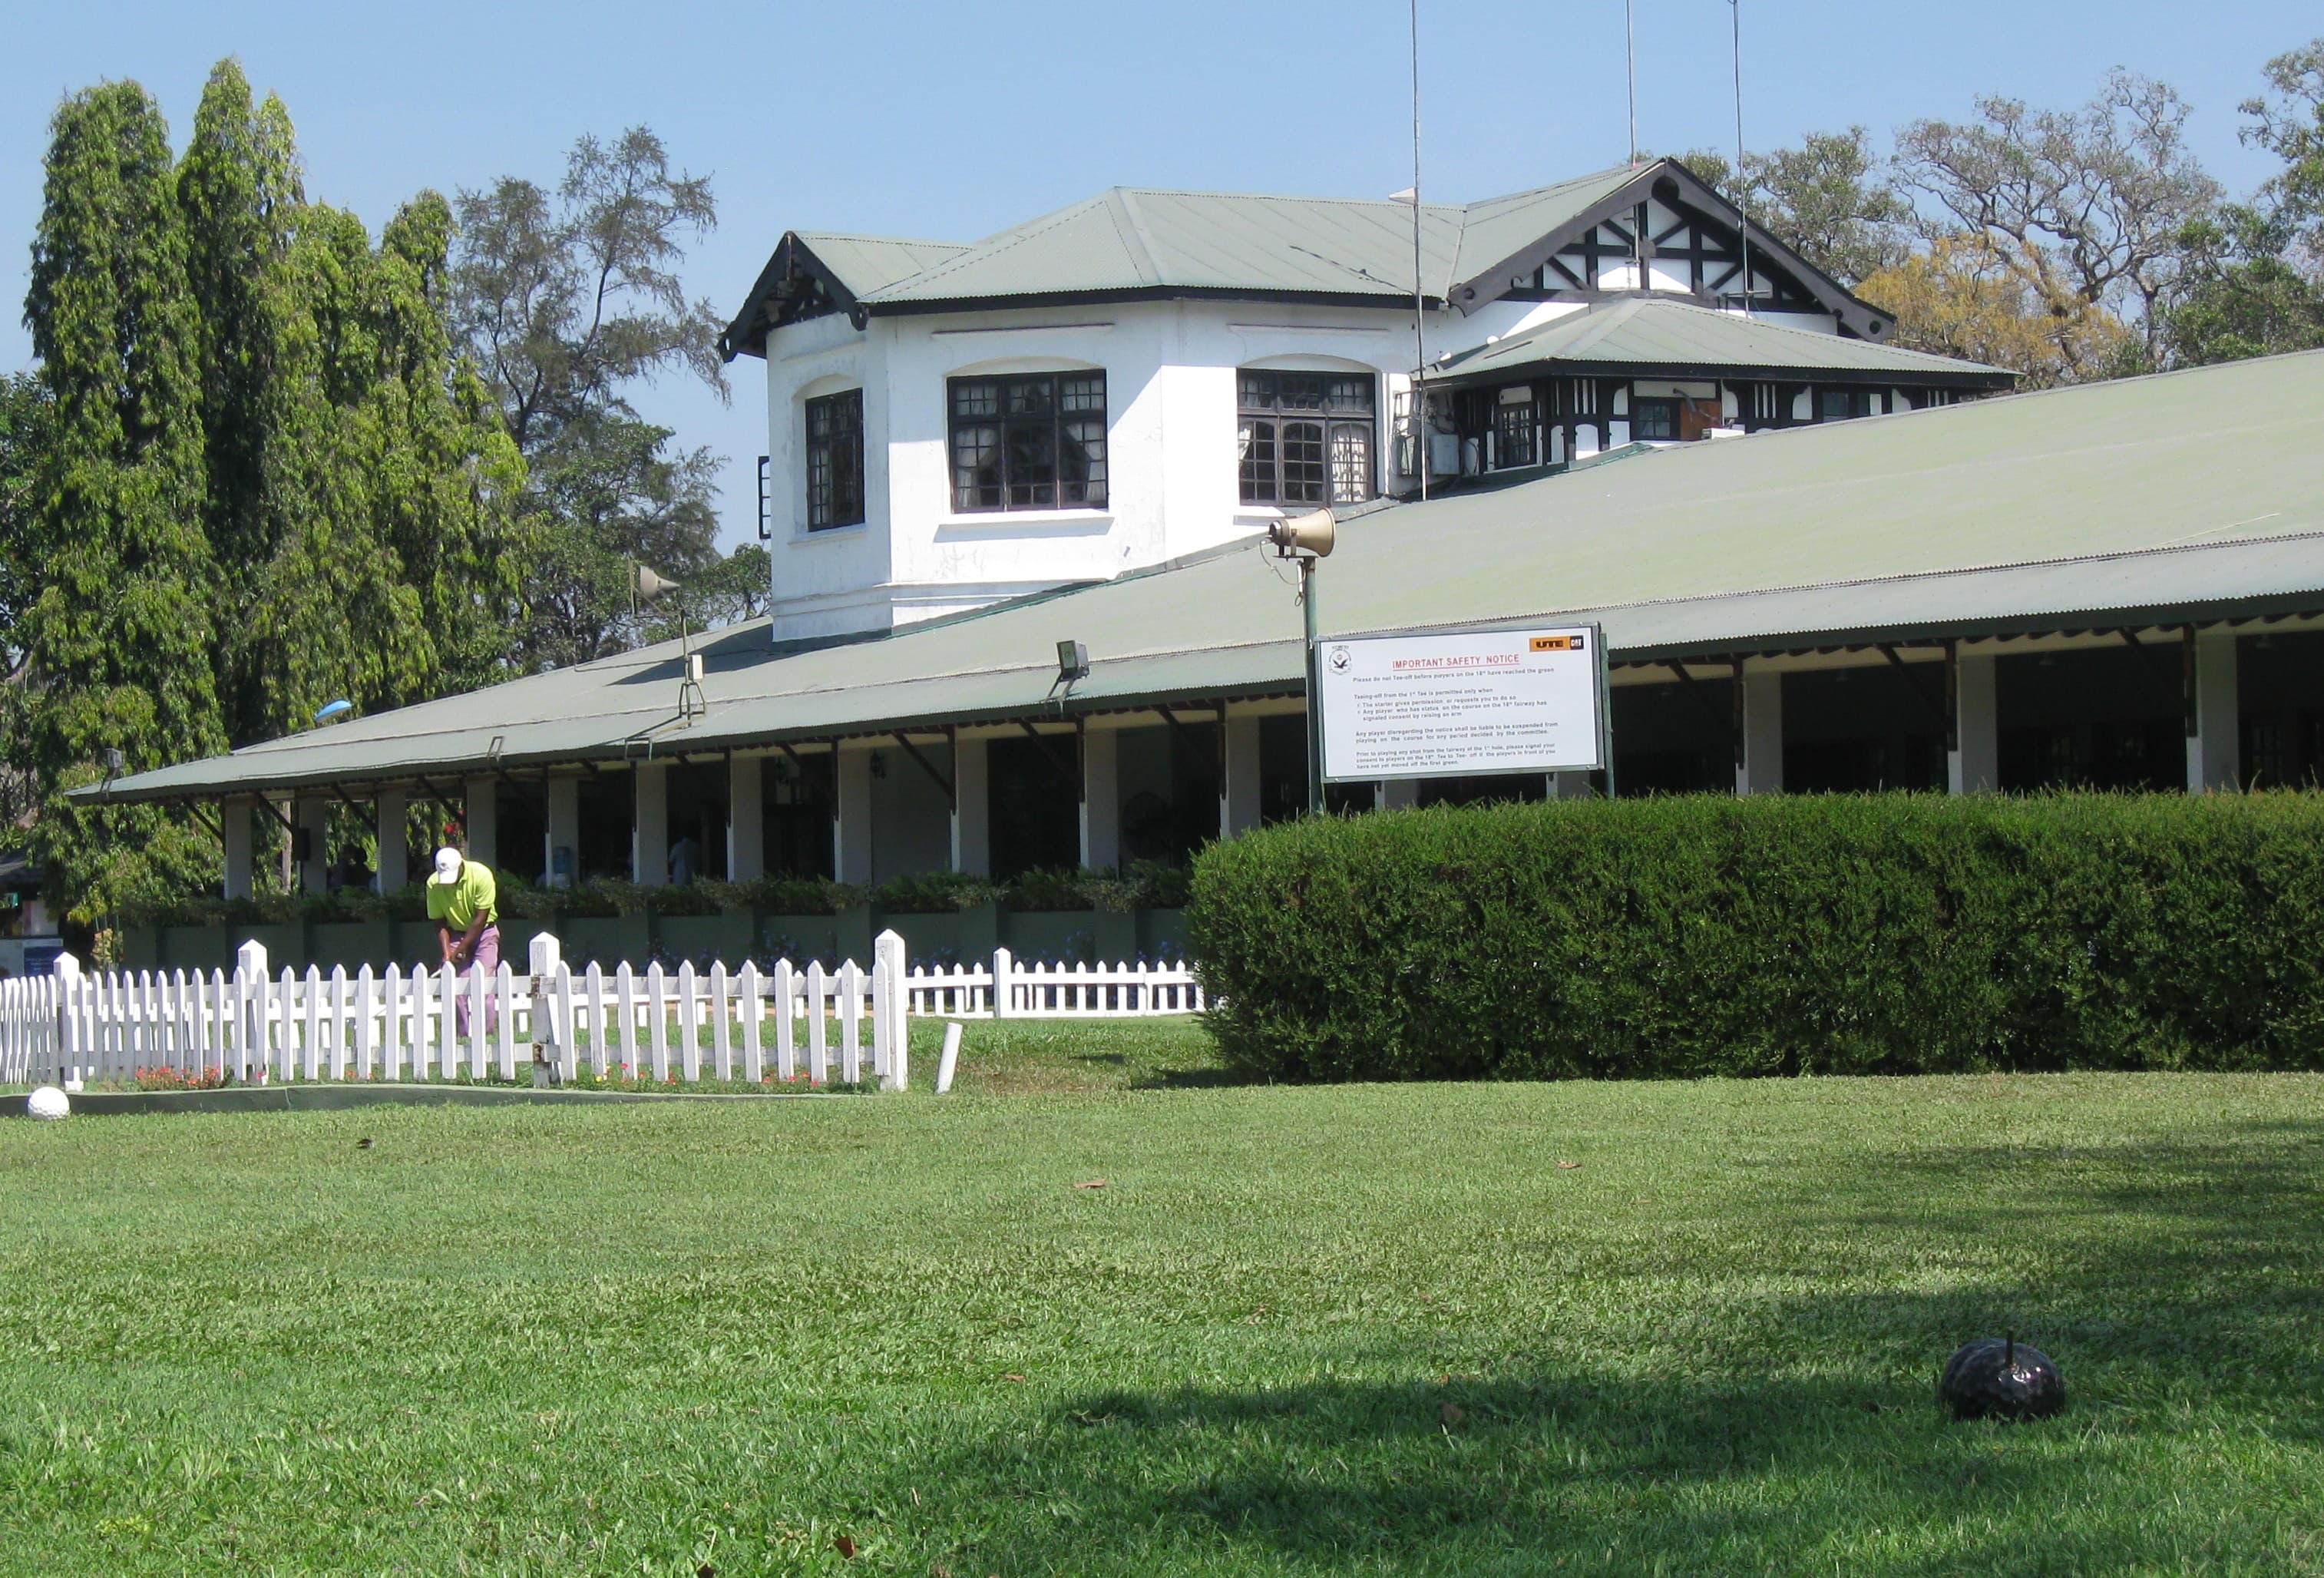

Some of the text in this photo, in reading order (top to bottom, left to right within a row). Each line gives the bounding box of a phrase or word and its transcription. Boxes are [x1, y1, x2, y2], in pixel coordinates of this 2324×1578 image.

[1536, 638, 1582, 649] UTE CAT
[1393, 654, 1519, 668] IMPORTANT SAFETY NOTICE
